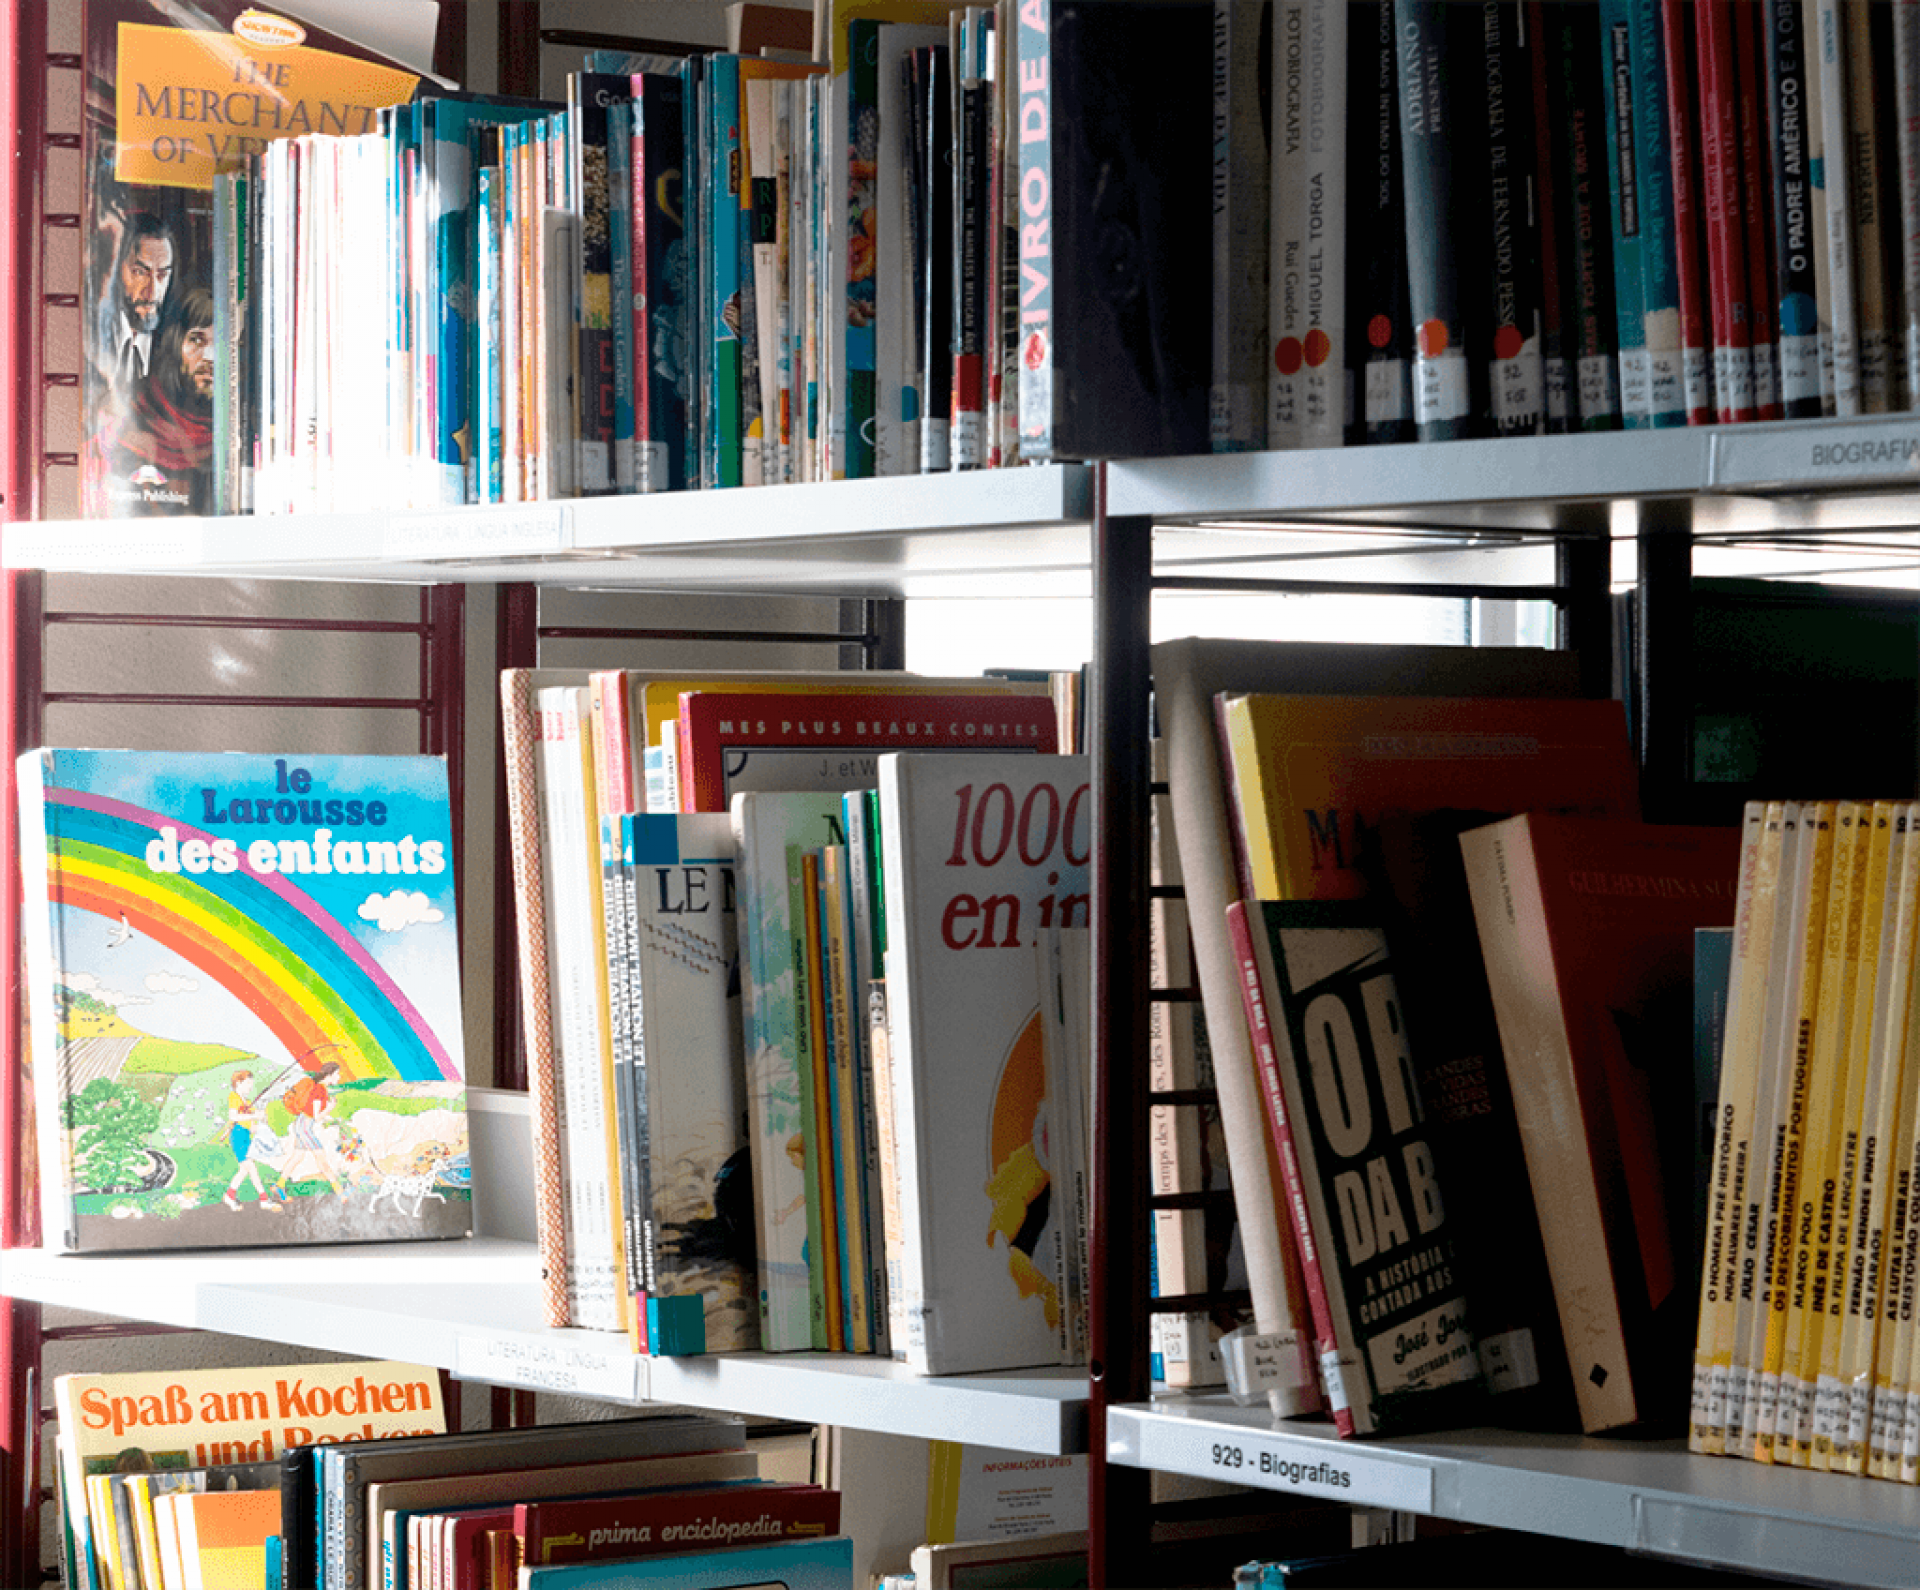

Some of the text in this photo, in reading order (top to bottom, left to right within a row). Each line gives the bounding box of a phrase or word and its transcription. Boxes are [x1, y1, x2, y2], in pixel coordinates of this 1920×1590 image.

[229, 58, 291, 87] THE
[1405, 22, 1424, 135] ADRIANO
[135, 82, 377, 136] MERCHANT
[1020, 56, 1048, 144] DE
[152, 136, 194, 164] OF
[1779, 38, 1807, 272] O PADRE AMÉRICO E A
[1309, 171, 1324, 327] MIGUEL TORGA
[1491, 145, 1517, 326] DE FERNANDO PESS
[1284, 241, 1299, 331] Rui Guedes
[719, 720, 1039, 737] MES PLUS BEAUX CONTES
[274, 758, 312, 794] le
[839, 758, 856, 777] et
[200, 788, 389, 826] Larousse
[145, 825, 446, 875] des enfants
[655, 867, 710, 915] LE
[940, 892, 1021, 950] en
[1154, 1122, 1168, 1147] des
[1734, 1139, 1748, 1202] PEREIRA
[1774, 1018, 1811, 1311] OS DESCOBRIMENTOS PORTUGUESES
[1840, 1132, 1858, 1220] LENCASTRE
[1333, 1139, 1446, 1268] DA B
[1707, 1104, 1735, 1302] O HOMEM PRÉ HISTÓRICO
[1764, 1124, 1787, 1285] AFONSO HENRIQUES
[1849, 1135, 1877, 1316] FERNÃO MENDES PINTO
[1793, 1201, 1814, 1309] MARCO POLO
[1812, 1179, 1836, 1313] INÊS DE CASTRO
[1837, 1225, 1848, 1246] DE
[1887, 1169, 1910, 1321] AS LUTAS LIBERAIS
[1359, 1266, 1453, 1326] CONTADA AOS
[1365, 1245, 1444, 1297] A HISTÓRIA
[1832, 1250, 1846, 1298] FILIPA
[1864, 1297, 1875, 1320] OS
[487, 1340, 558, 1364] LITERATURA
[1393, 1320, 1430, 1366] José
[516, 1366, 578, 1388] FRANCESA
[80, 1375, 432, 1437] Spaß am Kochen
[195, 1430, 275, 1467] und
[982, 1457, 1047, 1473] INFORMAÇÕES
[1211, 1443, 1243, 1468] 929
[1259, 1451, 1352, 1488] Biografias
[587, 1514, 783, 1551] prima enciclopedia
